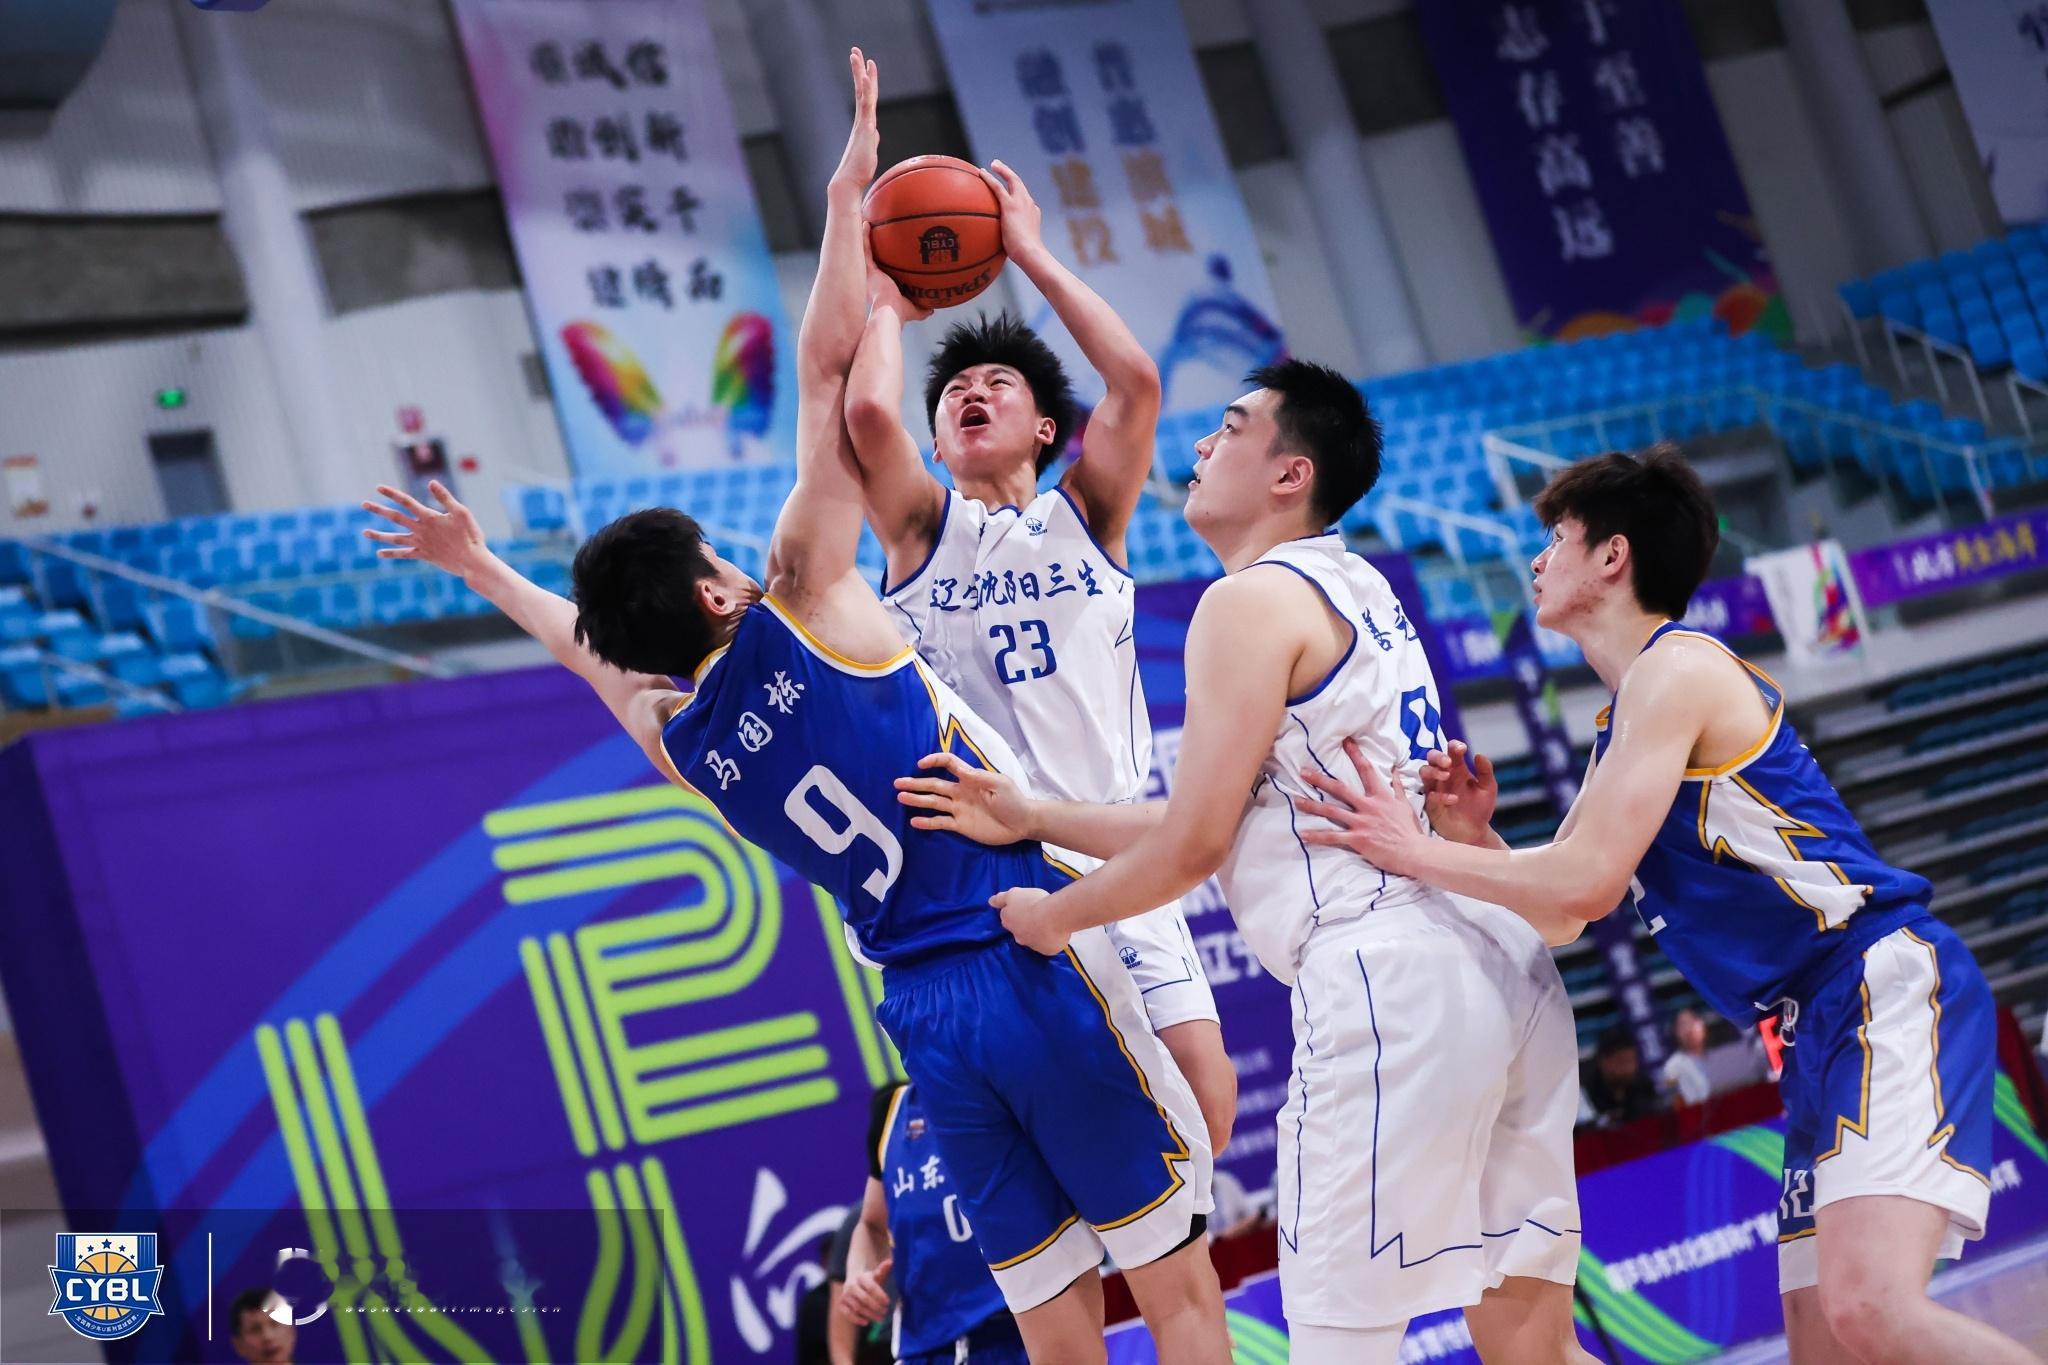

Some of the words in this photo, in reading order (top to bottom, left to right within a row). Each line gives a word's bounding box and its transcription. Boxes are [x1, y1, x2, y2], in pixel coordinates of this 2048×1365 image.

[923, 237, 955, 250] CYBL
[900, 266, 993, 300] SPALDIN
[989, 619, 1057, 685] 23
[704, 670, 805, 790] 马国栋
[784, 764, 904, 903] 9
[892, 1154, 945, 1199] 山东
